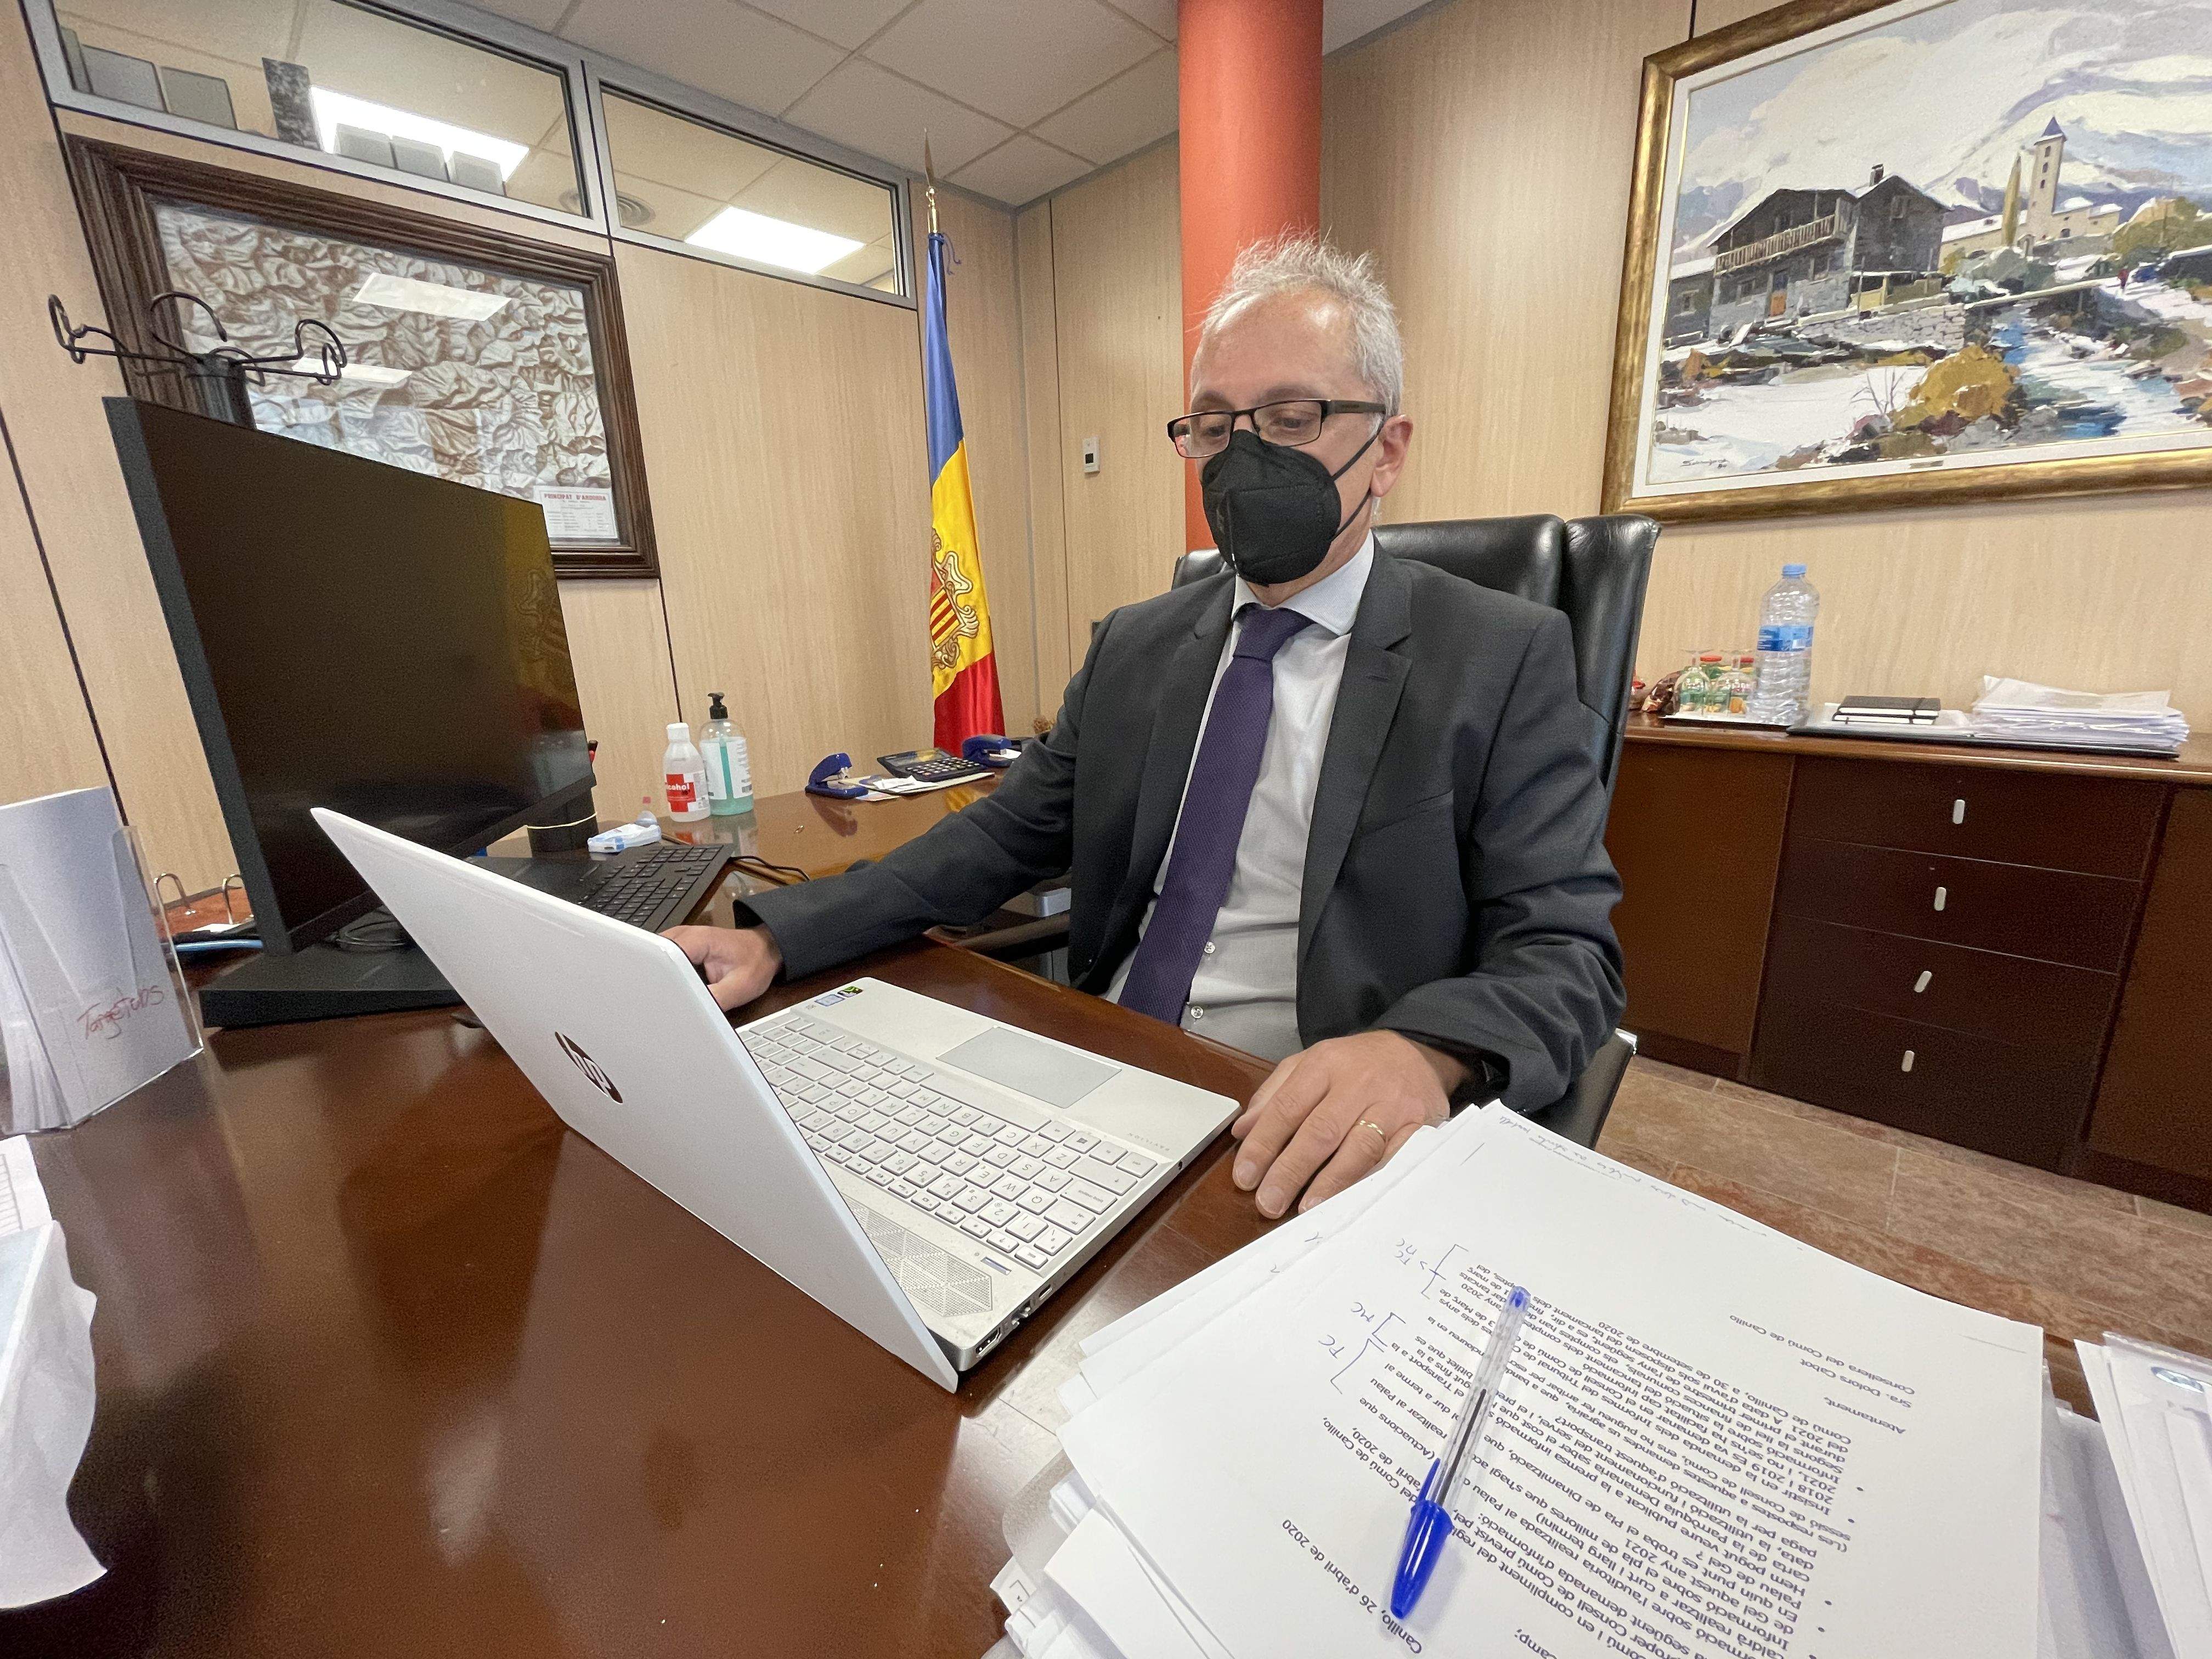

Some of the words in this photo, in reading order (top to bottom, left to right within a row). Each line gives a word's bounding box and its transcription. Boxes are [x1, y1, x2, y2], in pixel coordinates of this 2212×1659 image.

[1126, 1132, 1170, 1152] PAVILION
[1459, 1272, 1490, 1293] tancats
[1466, 1267, 1489, 1282] març
[1461, 1283, 1483, 1299] 2020
[1532, 1296, 1551, 1308] dels
[1438, 1298, 1460, 1313] anys
[1452, 1296, 1474, 1313] Març
[1460, 1313, 1480, 1326] dels
[1553, 1307, 1604, 1338] tancament
[1598, 1322, 1624, 1338] 2020
[1729, 1315, 1767, 1334] Canillo
[1558, 1330, 1601, 1355] comptes
[1562, 1342, 1583, 1355] dels
[1592, 1336, 1635, 1362] següent,
[1787, 1339, 1822, 1358] Comú
[1434, 1362, 1452, 1377] fins
[1446, 1357, 1473, 1379] bitllet
[1537, 1348, 1566, 1368] Comú
[1584, 1353, 1641, 1387] tancament
[1624, 1345, 1675, 1372] disposem
[1637, 1361, 1663, 1378] l'any
[1641, 1343, 1693, 1371] setembre
[1799, 1358, 1836, 1378] Cabot
[1825, 1355, 1844, 1366] del
[1396, 1370, 1423, 1395] terme
[1408, 1355, 1452, 1391] Transport
[1537, 1359, 1578, 1387] Tribunal
[1582, 1363, 1638, 1397] informació
[1625, 1364, 1680, 1396] comunals,
[1678, 1371, 1700, 1385] sols
[1839, 1375, 1881, 1396] Dolors
[1848, 1365, 1915, 1394] Consellera
[1370, 1378, 1396, 1401] Palau
[1546, 1383, 1579, 1402] arribar
[1583, 1375, 1623, 1400] Consell
[1683, 1384, 1736, 1414] trimestre
[1702, 1383, 1739, 1403] d'avui
[1886, 1393, 1911, 1408] Sra.
[1565, 1402, 1606, 1429] agrairia,
[1601, 1395, 1652, 1427] Informes
[1664, 1396, 1710, 1421] situació
[1683, 1395, 1732, 1423] finances
[1741, 1402, 1769, 1418] data
[1745, 1392, 1788, 1417] Canillo,
[1824, 1397, 1905, 1434] Atentament,
[1323, 1417, 1354, 1449] Canillo,
[1406, 1408, 1447, 1439] realitzar
[1520, 1419, 1544, 1436] cost
[1537, 1415, 1573, 1440] servei,
[1598, 1410, 1638, 1435] pugueu
[1655, 1424, 1679, 1440] dels
[1656, 1415, 1710, 1444] demanar
[1663, 1406, 1707, 1434] facilitat
[1738, 1413, 1781, 1435] primer
[1352, 1427, 1378, 1454] 2020,
[1378, 1413, 1435, 1459] (Actuacions
[1495, 1417, 1551, 1456] informació
[1554, 1416, 1612, 1453] transport?
[1727, 1427, 1763, 1448] sobre
[1755, 1430, 1774, 1443] llei
[1792, 1425, 1823, 1444] 2021
[1813, 1424, 1851, 1444] Comú
[1355, 1448, 1369, 1461] de
[1558, 1443, 1592, 1464] saber
[1622, 1436, 1680, 1470] demandes
[1683, 1439, 1741, 1472] demanda
[1730, 1440, 1763, 1460] se'ns
[1793, 1447, 1843, 1474] Segons
[1799, 1439, 1845, 1462] durant
[1369, 1460, 1399, 1488] Comú
[1508, 1449, 1582, 1502] Dinamització,
[1554, 1453, 1598, 1482] premsa
[1594, 1450, 1678, 1503] funcionament
[1614, 1449, 1667, 1482] d'aquest
[1681, 1455, 1718, 1480] Comú,
[1751, 1463, 1785, 1483] 2019
[1767, 1447, 1839, 1484] Informació
[1489, 1468, 1523, 1492] s'hagi
[1594, 1463, 1660, 1506] Demanaria
[1683, 1469, 1736, 1500] aquestes
[1798, 1471, 1836, 1494] 2021,
[1399, 1486, 1417, 1502] del
[1472, 1485, 1503, 1511] Palau
[1670, 1481, 1731, 1517] utilització
[1740, 1487, 1785, 1513] Consell
[1781, 1489, 1831, 1515] Insistir
[1797, 1484, 1833, 1505] 2018
[1549, 1507, 1599, 1541] millores
[1625, 1495, 1677, 1528] publicat
[1663, 1503, 1728, 1543] Parròquia
[1690, 1504, 1753, 1542] utilització
[1751, 1504, 1814, 1537] respostes
[1282, 1519, 1310, 1548] 2020
[1474, 1526, 1516, 1559] previst
[1478, 1513, 1554, 1569] d'informació:
[1520, 1517, 1579, 1561] realitzada
[1536, 1513, 1584, 1550] termini)
[1680, 1526, 1719, 1553] veure
[1809, 1520, 1850, 1541] sessió
[1818, 1534, 1847, 1552] (Les
[1310, 1545, 1324, 1561] de
[1587, 1545, 1616, 1571] llarg
[1625, 1538, 1657, 1563] 2021
[1643, 1534, 1678, 1560] troba
[1776, 1547, 1814, 1570] data,
[1781, 1537, 1817, 1558] paga
[1517, 1557, 1554, 1588] Comú
[1660, 1560, 1687, 1579] any
[1722, 1549, 1766, 1575] pogut
[1772, 1560, 1809, 1582] carta
[1324, 1560, 1359, 1595] d'abril
[1498, 1561, 1573, 1617] compliment
[1582, 1559, 1647, 1607] l'auditoria
[1627, 1571, 1655, 1592] curt
[1662, 1576, 1702, 1602] sobre
[1701, 1567, 1736, 1590] punt
[1770, 1573, 1805, 1596] Hem
[1359, 1595, 1377, 1614] 26
[1558, 1568, 1627, 1617] demanada
[1689, 1576, 1740, 1607] aquest
[1740, 1588, 1773, 1609] quin
[1759, 1583, 1801, 1610] Palau
[1576, 1599, 1627, 1637] Consell
[1651, 1602, 1692, 1629] sobre
[1671, 1599, 1731, 1635] realitzar
[1706, 1601, 1789, 1651] Informació
[1743, 1605, 1768, 1623] Gel
[1381, 1610, 1421, 1654] Canillo,
[1629, 1615, 1690, 1655] següent
